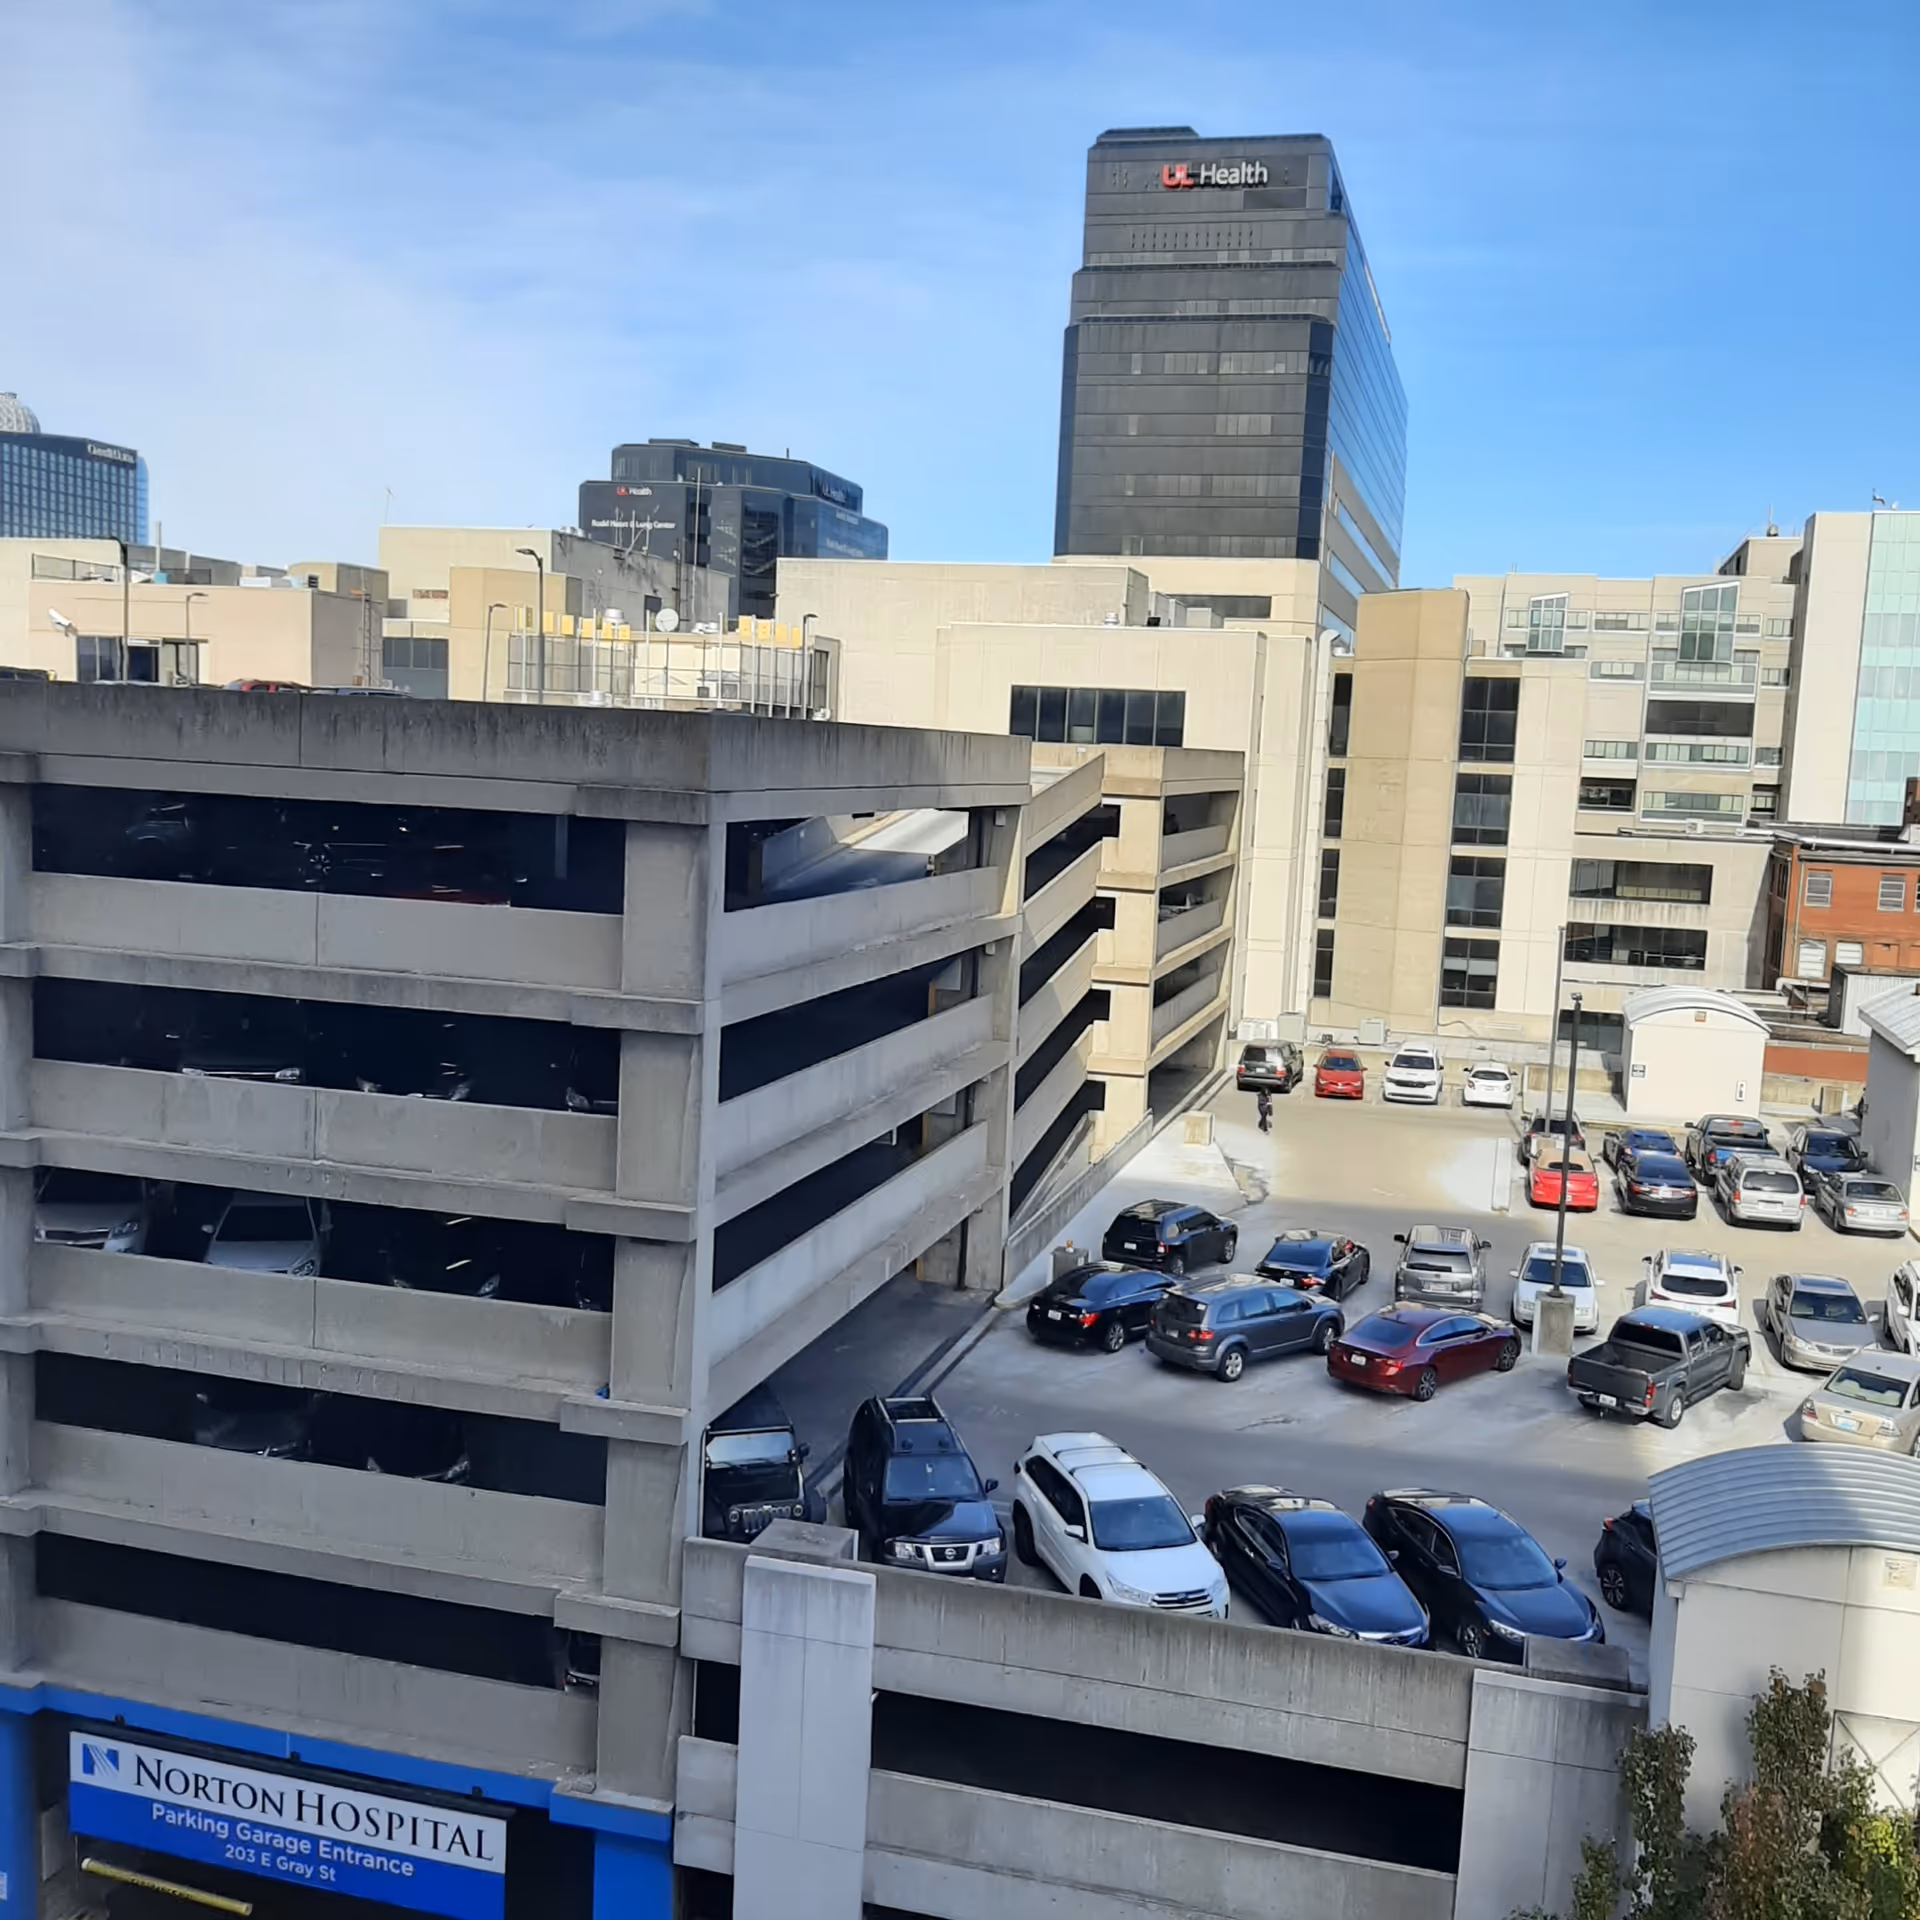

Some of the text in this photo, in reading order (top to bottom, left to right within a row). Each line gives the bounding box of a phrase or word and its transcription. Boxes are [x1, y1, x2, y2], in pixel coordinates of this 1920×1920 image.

[1200, 161, 1268, 186] Health
[134, 1754, 494, 1861] NORTON HOSPITAL
[152, 1803, 414, 1876] Parking Garage Entrance
[225, 1844, 336, 1882] 203 E Gray St
